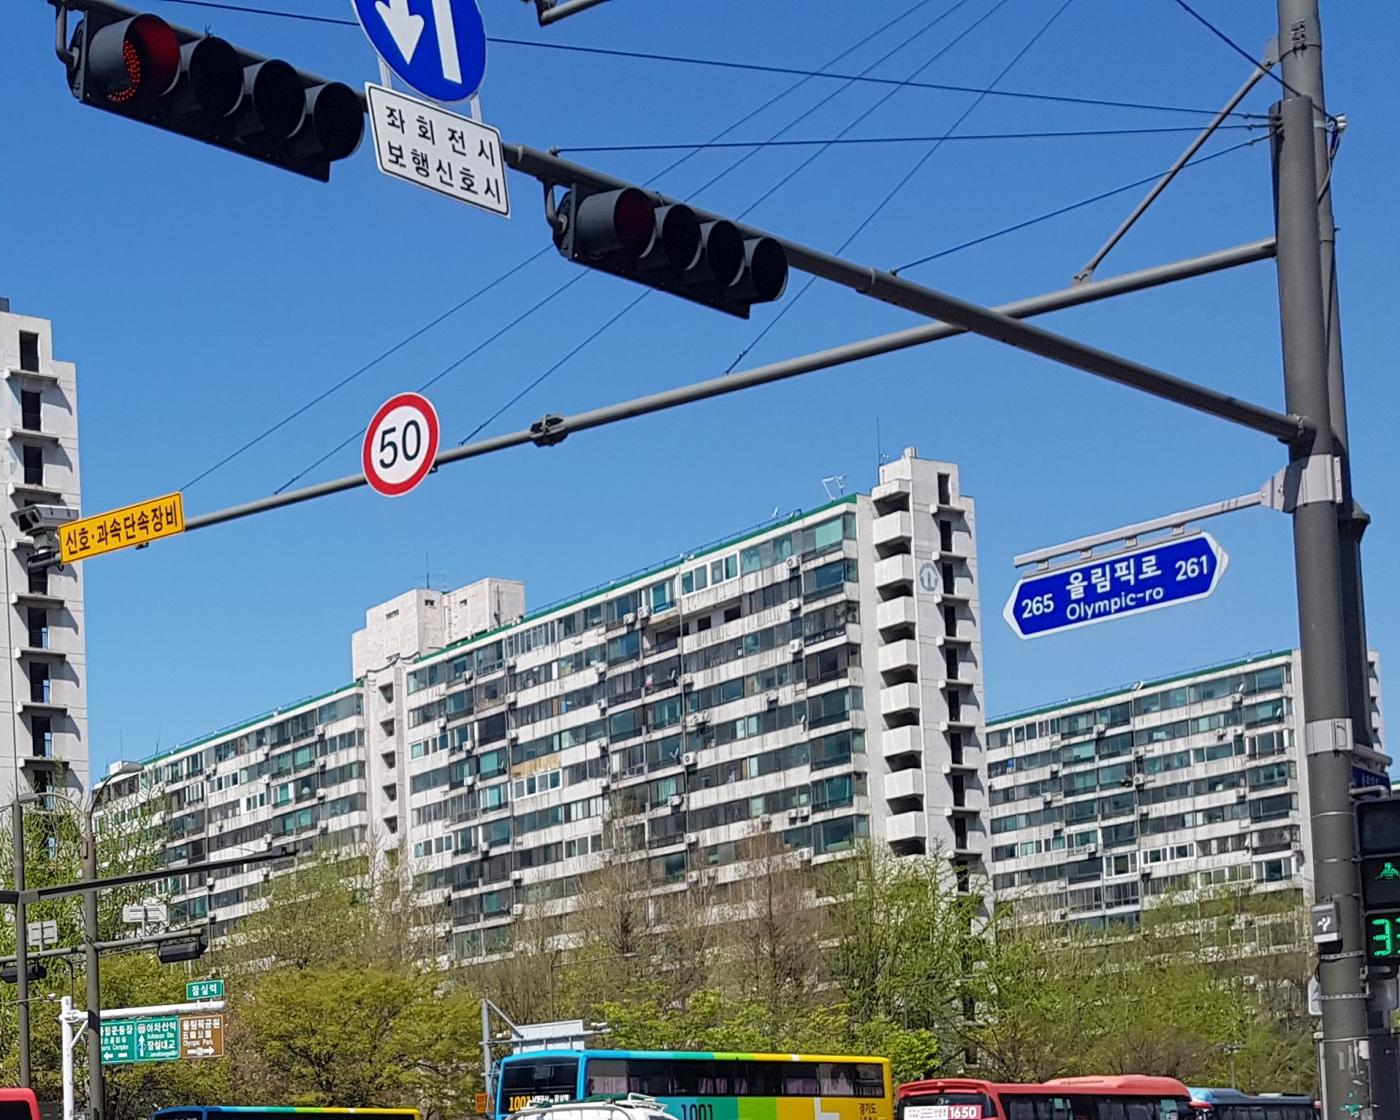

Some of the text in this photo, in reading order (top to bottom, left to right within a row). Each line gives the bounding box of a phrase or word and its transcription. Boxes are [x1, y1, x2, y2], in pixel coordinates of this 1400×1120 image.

[386, 141, 503, 205] 보행신호시
[378, 419, 422, 470] 50
[65, 501, 178, 555] 신호·과속단속장비
[1021, 554, 1208, 619] 265 올림픽로 261
[1066, 586, 1164, 621] Olympic-ro
[191, 983, 217, 996] 잠실역
[183, 1018, 220, 1030] 올림픽공원
[147, 1040, 175, 1051] 잠실대교
[858, 1102, 878, 1116] 경기도
[950, 1106, 977, 1119] 1650
